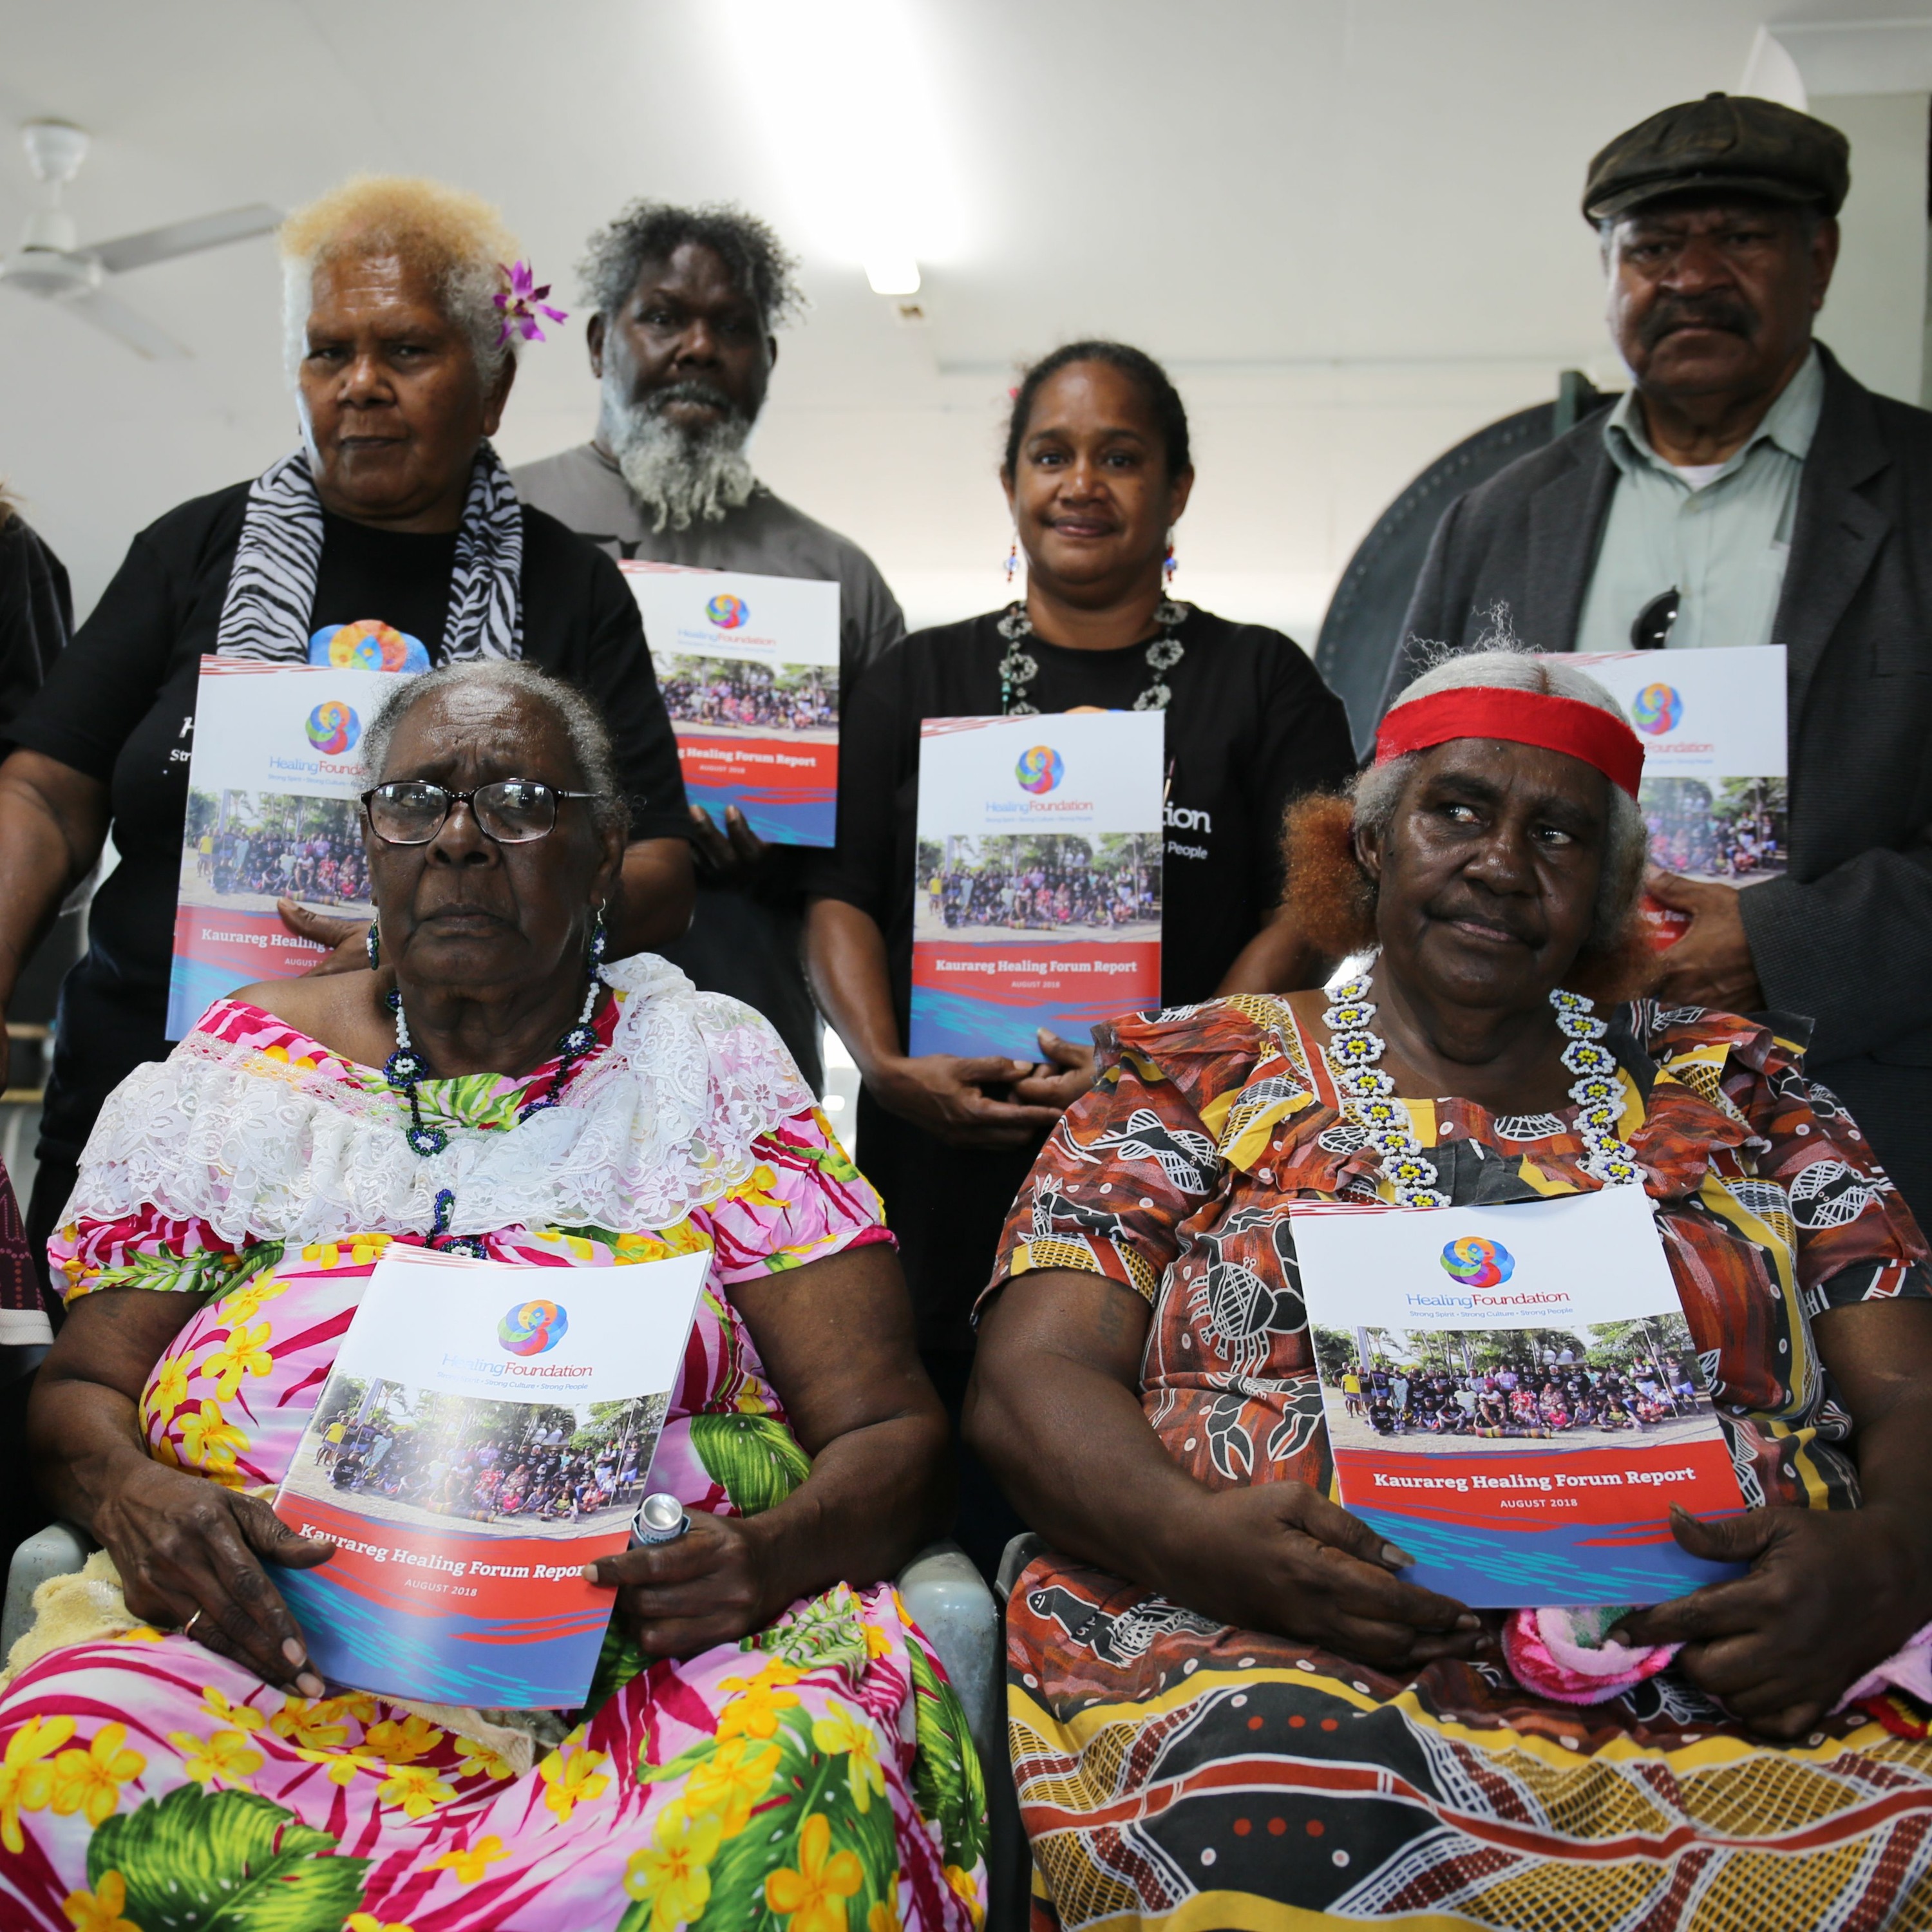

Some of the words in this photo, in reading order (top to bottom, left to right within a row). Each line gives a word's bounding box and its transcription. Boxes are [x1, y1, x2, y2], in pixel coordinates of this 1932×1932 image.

[269, 756, 362, 776] HealingFound
[687, 747, 734, 762] Healing
[735, 750, 774, 764] Forum
[776, 753, 817, 768] Report
[1168, 841, 1208, 859] People
[202, 928, 268, 948] Kaurareg
[270, 934, 326, 953] Healing
[285, 958, 317, 967] AUGUST
[936, 960, 995, 974] Kaurareg
[998, 960, 1047, 975] Healing
[1050, 961, 1092, 972] Forum
[1094, 960, 1137, 975] Report
[1406, 1292, 1571, 1309] HealingFoundation
[1548, 1307, 1573, 1315] People
[485, 1379, 508, 1388] Strong
[509, 1381, 535, 1389] Culture
[540, 1383, 564, 1391] Strong
[565, 1383, 589, 1391] People
[1373, 1472, 1469, 1492] Kaurareg
[1472, 1473, 1551, 1491] Healing
[1556, 1473, 1623, 1487] Forum
[1625, 1467, 1696, 1485] Report
[1500, 1499, 1546, 1508] AUGUST
[1550, 1498, 1578, 1508] 2018
[391, 1547, 466, 1577] Healing
[469, 1560, 529, 1578] Forum
[532, 1564, 585, 1582] Repor
[404, 1578, 448, 1593] AUGUST
[451, 1586, 477, 1597] 2018
